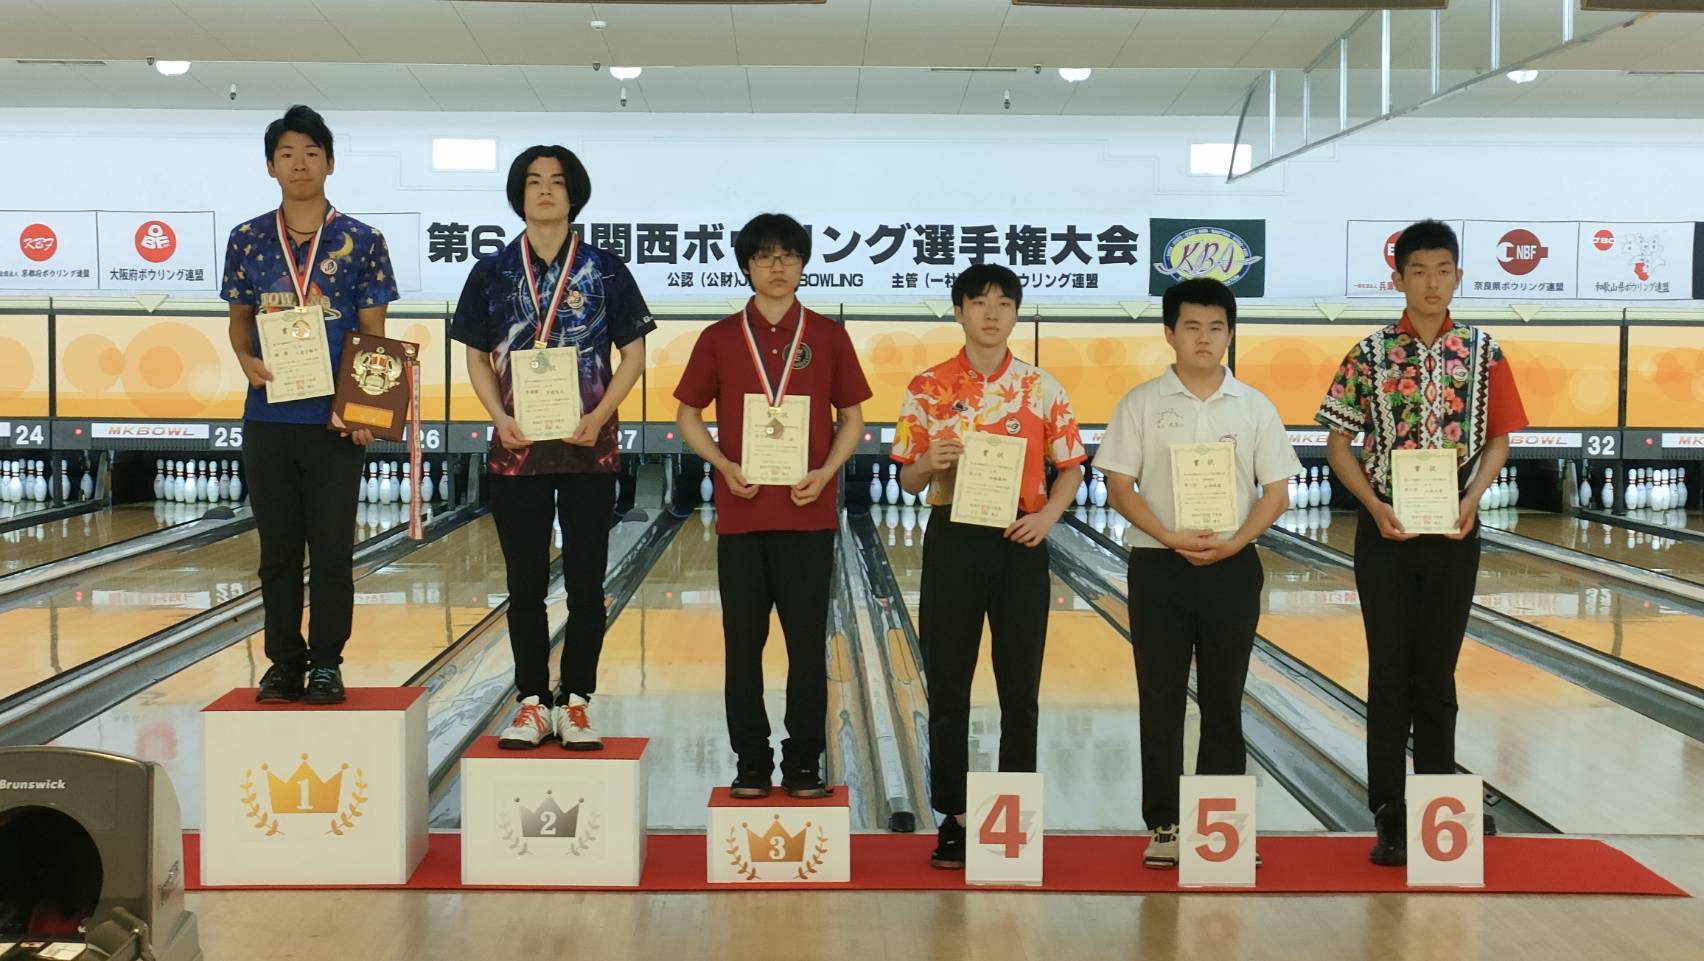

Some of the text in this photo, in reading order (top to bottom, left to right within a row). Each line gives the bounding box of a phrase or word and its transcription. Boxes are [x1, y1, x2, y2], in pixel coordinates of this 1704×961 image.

[427, 222, 1139, 265] 第6関西ボング選手権大会
[1516, 245, 1537, 261] NBF
[110, 268, 204, 282] 大阪府ボウリング連盟
[800, 273, 864, 287] BOWLING
[1474, 281, 1564, 292] 奈良県ボウリング連盟
[15, 425, 44, 445] 24
[108, 426, 195, 436] MKBOWL
[215, 427, 243, 447] 25
[1587, 435, 1615, 455] 32
[0, 779, 66, 790] Brunswick
[296, 778, 313, 809] 1
[540, 811, 557, 835] 2
[979, 795, 1027, 859] 4
[1195, 798, 1239, 862] 5
[1422, 796, 1468, 861] 6
[768, 836, 786, 860] 3
